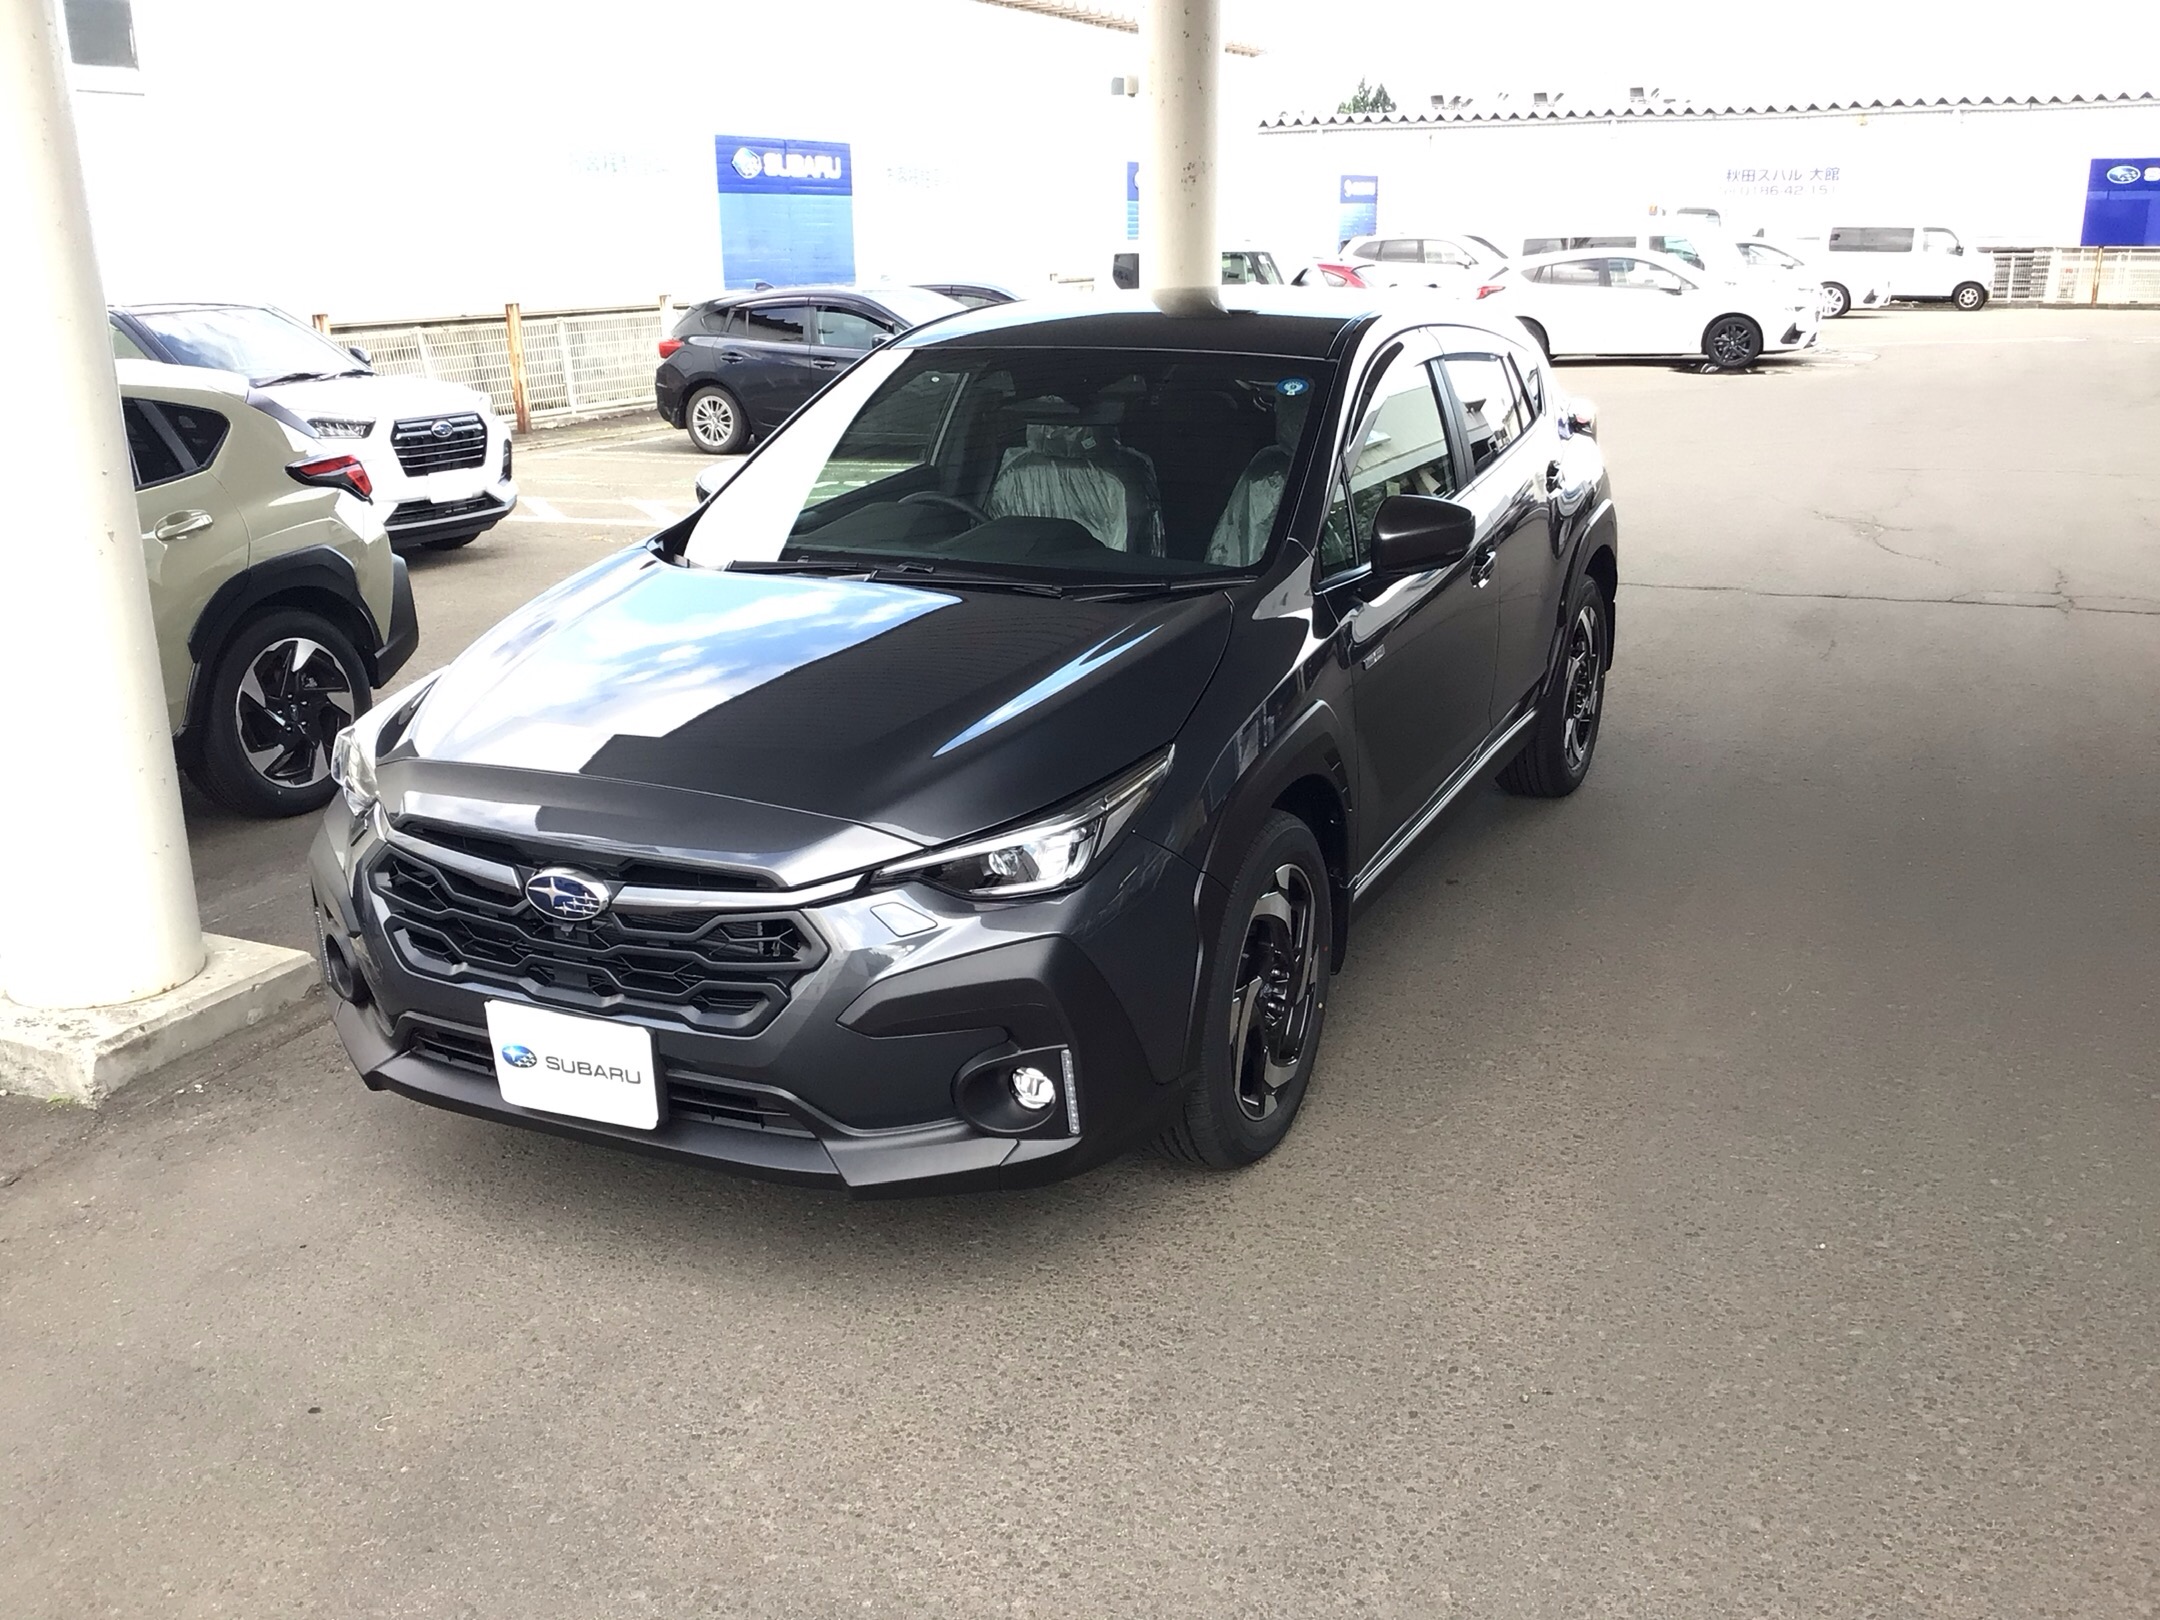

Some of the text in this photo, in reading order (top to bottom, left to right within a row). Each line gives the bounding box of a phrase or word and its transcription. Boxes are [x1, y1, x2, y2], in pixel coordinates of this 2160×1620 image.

[763, 152, 842, 179] SUBARU
[1809, 167, 1841, 182] 大館
[545, 1055, 641, 1085] SUBARU
